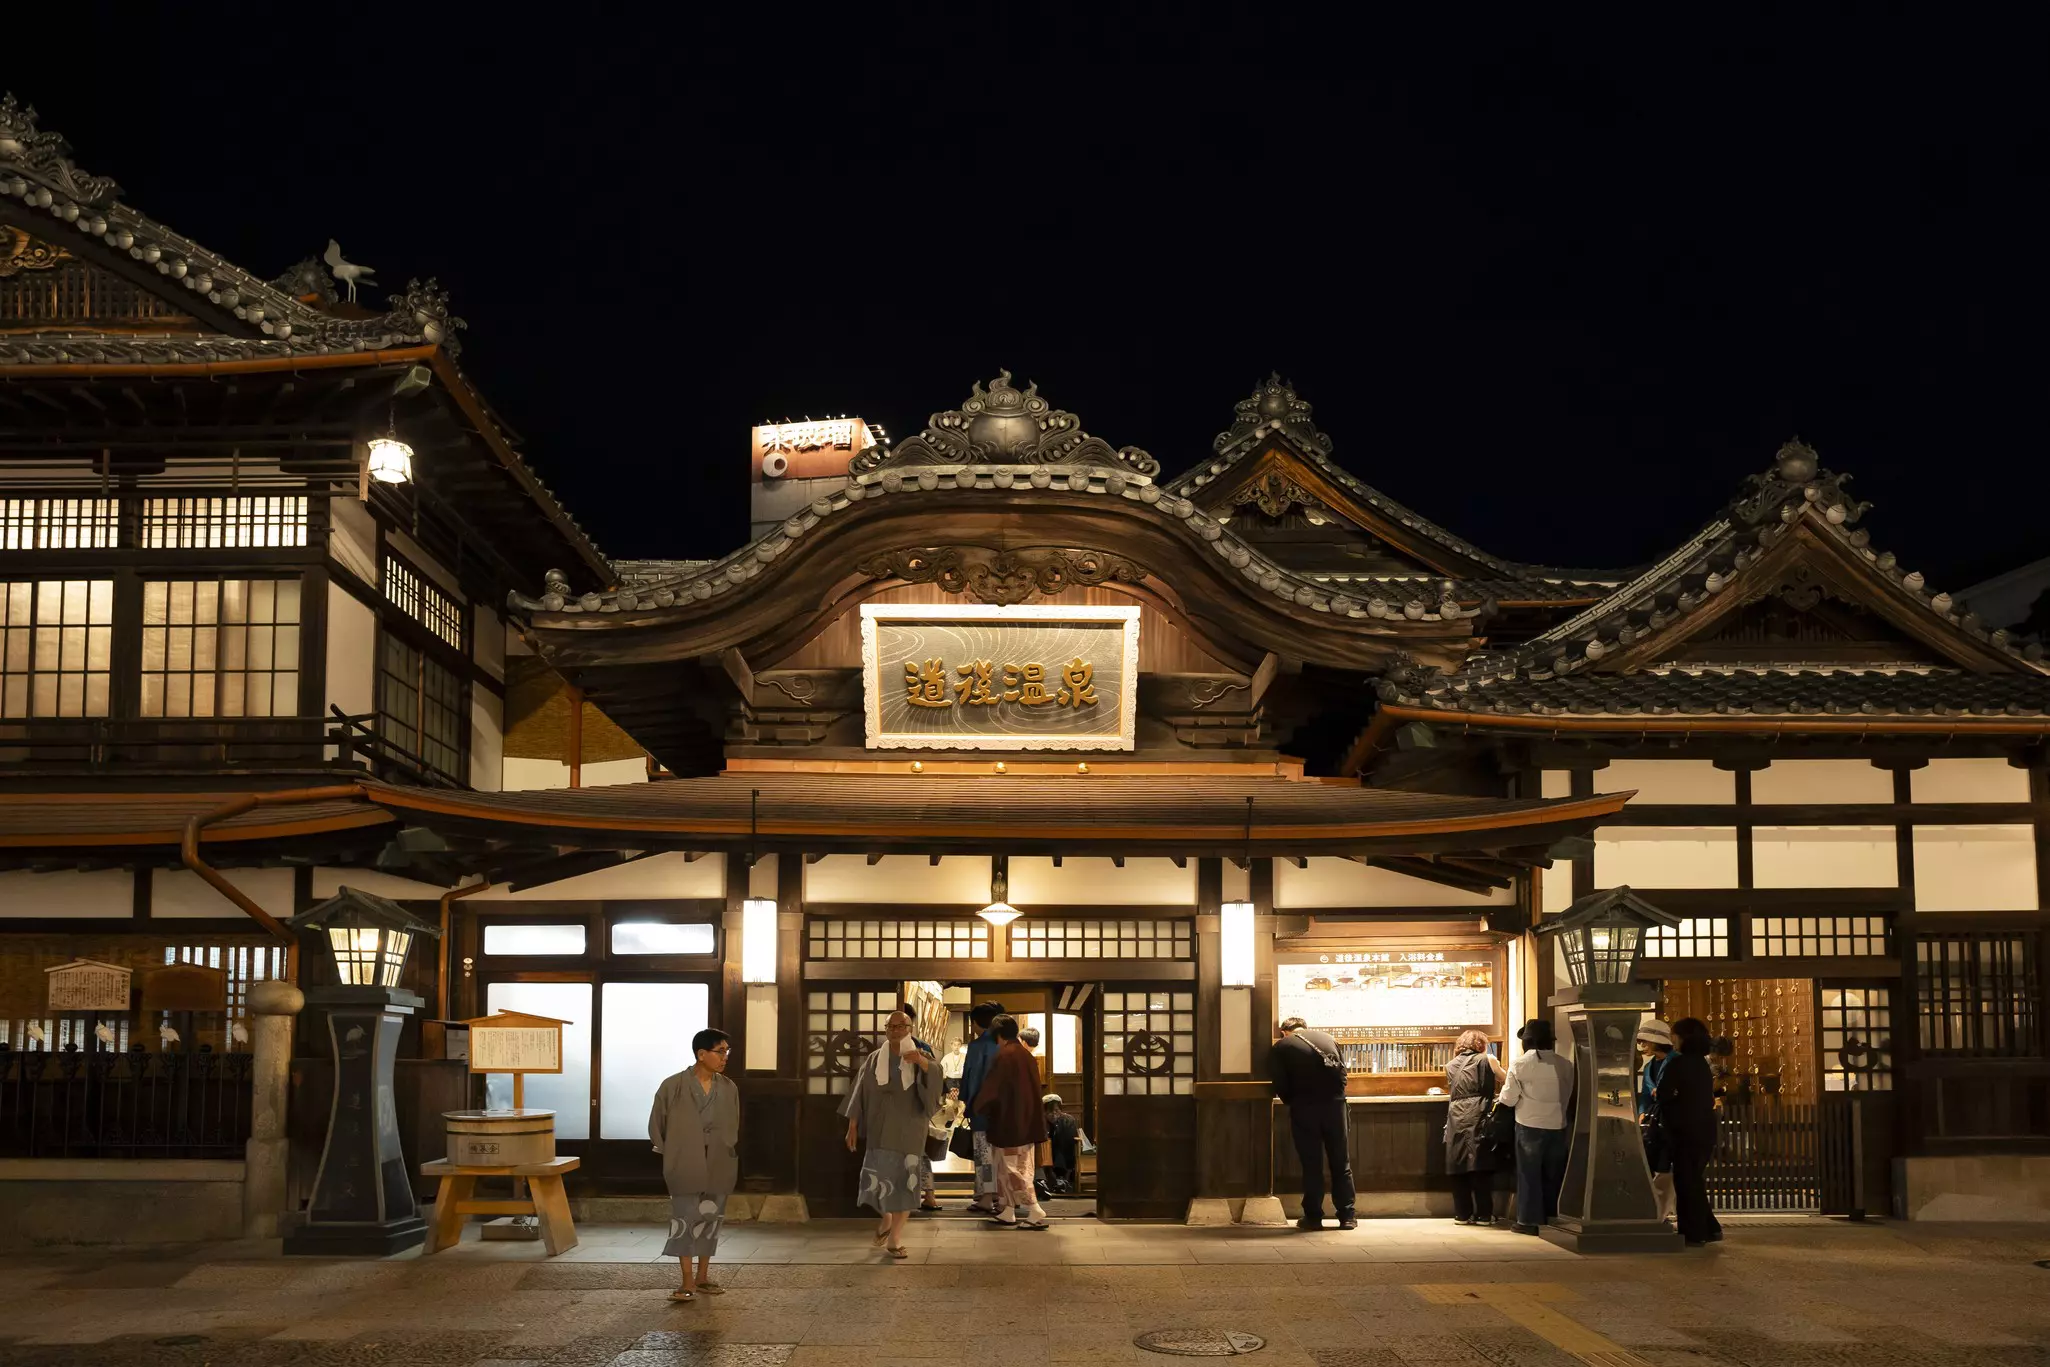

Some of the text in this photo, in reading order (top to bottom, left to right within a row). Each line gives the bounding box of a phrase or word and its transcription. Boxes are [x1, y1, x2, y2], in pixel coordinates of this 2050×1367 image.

[904, 656, 1099, 709] 道後温泉
[1398, 952, 1445, 962] 入浴料金表
